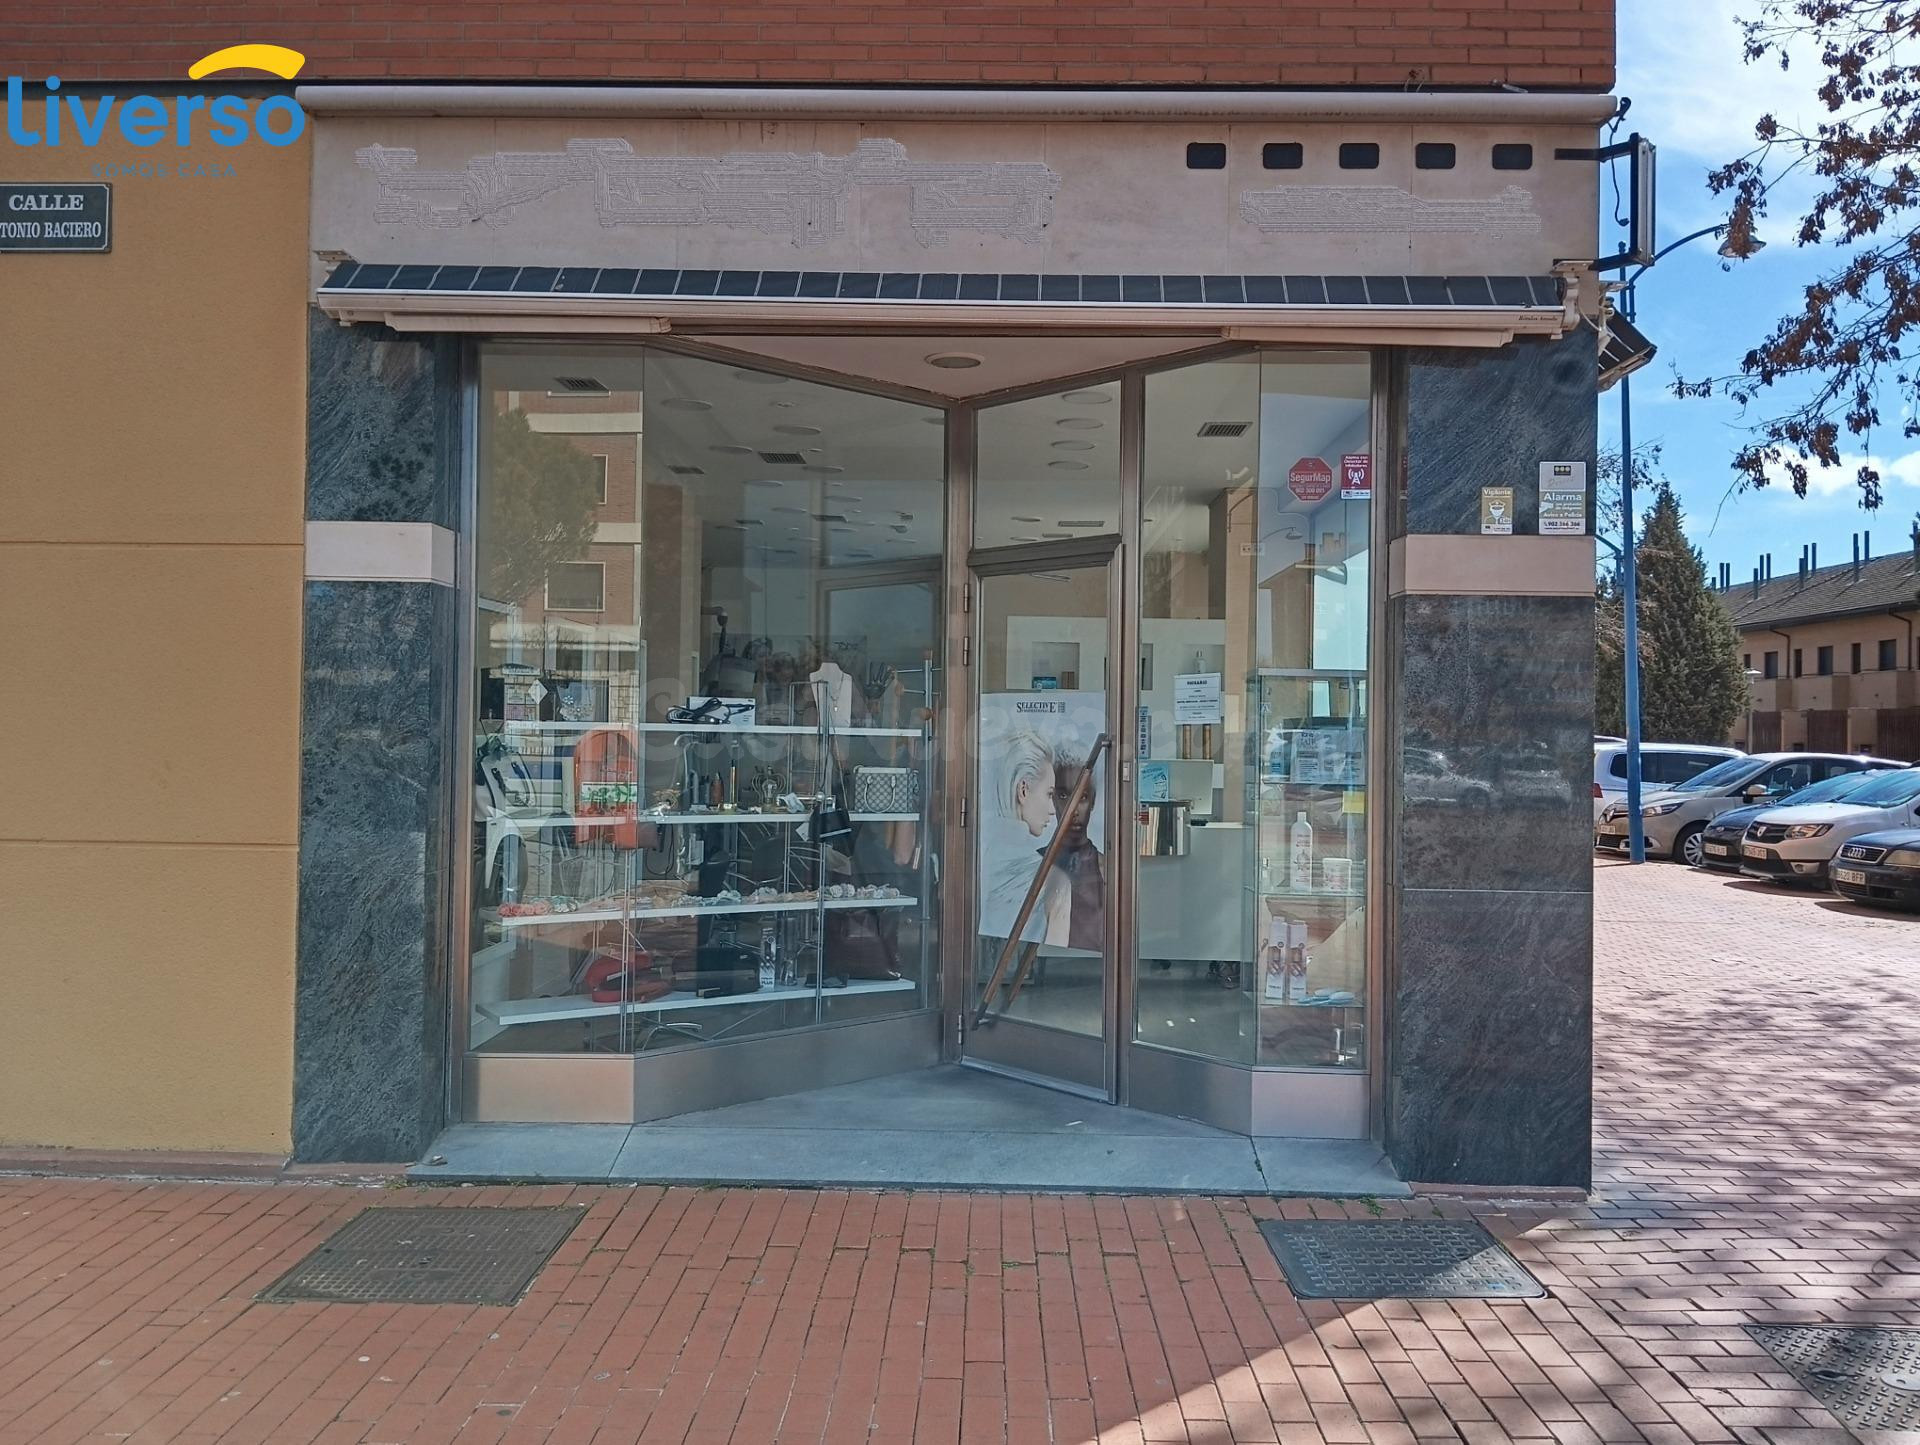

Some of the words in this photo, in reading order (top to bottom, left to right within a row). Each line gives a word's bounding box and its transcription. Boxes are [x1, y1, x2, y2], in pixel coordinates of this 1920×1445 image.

[8, 194, 84, 211] CALLE
[0, 222, 41, 238] TONIO
[44, 222, 102, 238] BACIERO
[1290, 472, 1331, 484] SegurMap
[1544, 492, 1582, 501] Alarma
[1016, 701, 1056, 713] SELECTIVE
